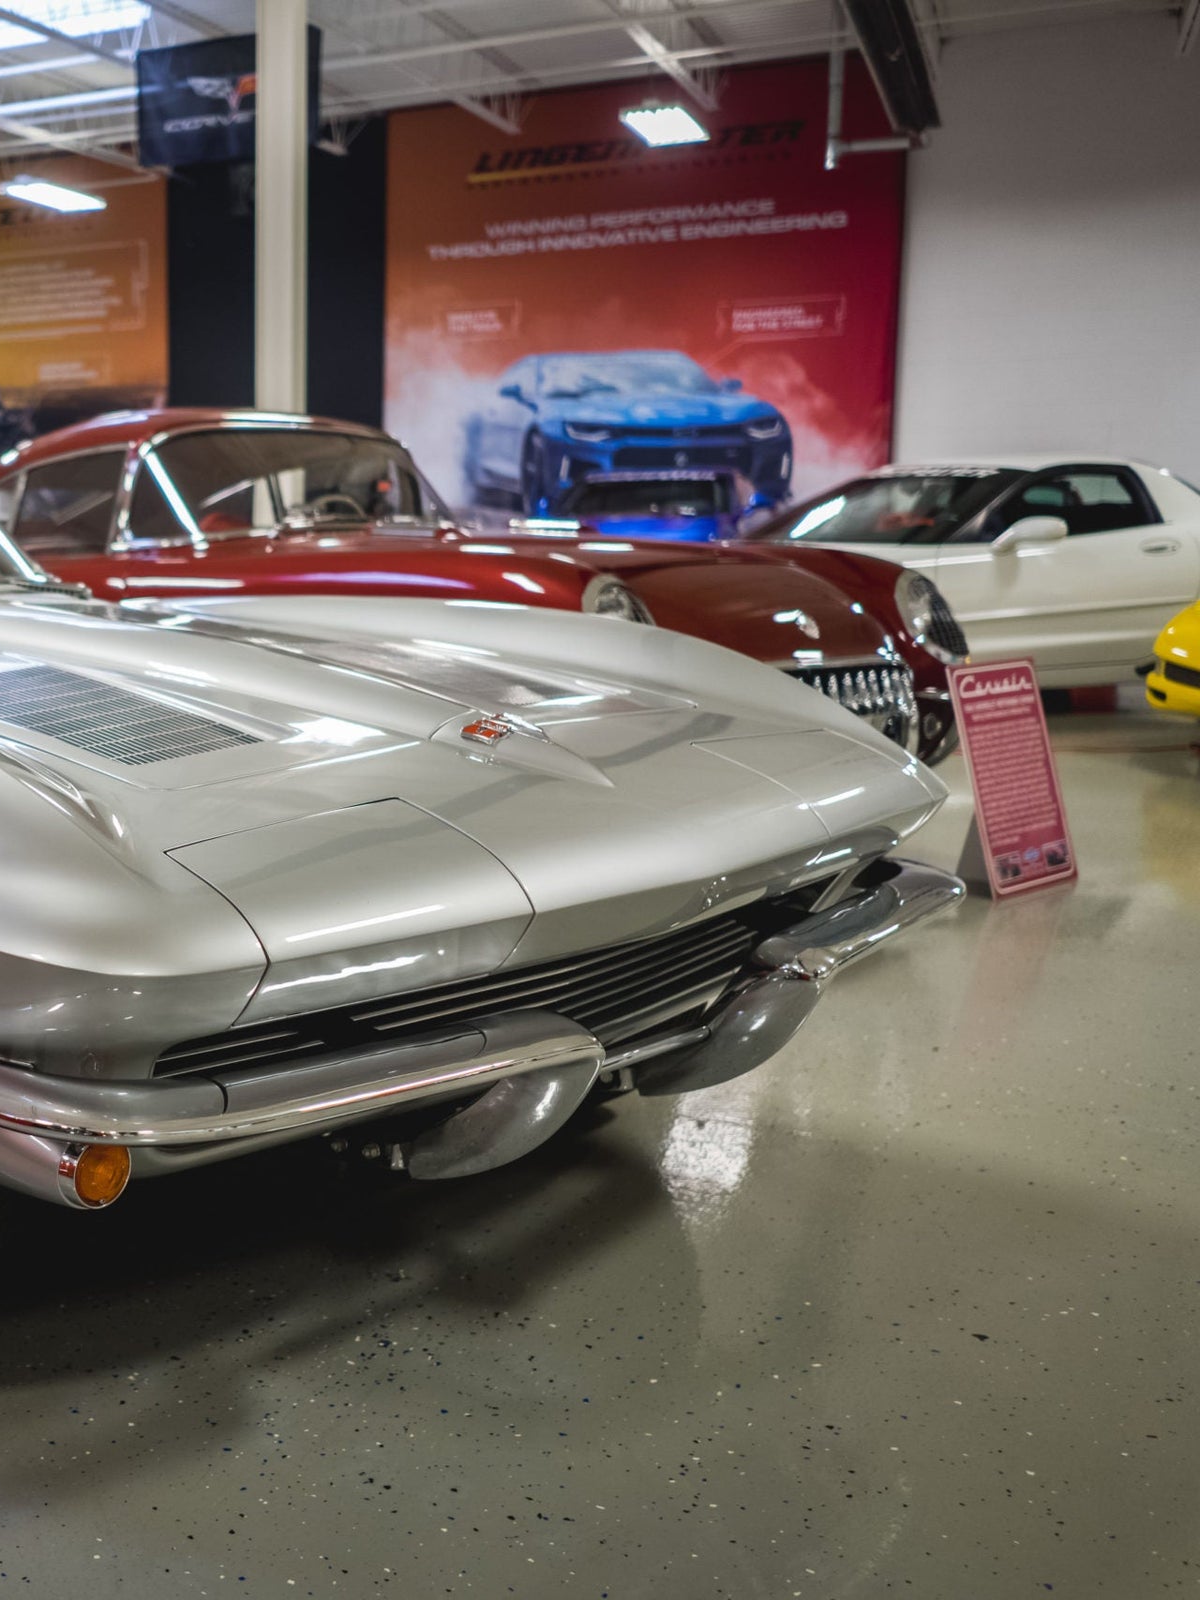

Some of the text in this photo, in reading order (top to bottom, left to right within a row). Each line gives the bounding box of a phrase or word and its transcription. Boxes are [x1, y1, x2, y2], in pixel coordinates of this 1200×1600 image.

[427, 210, 847, 260] THROUGH INNOVATIVE ENGINEERING
[485, 198, 776, 239] WINNING PERFORMANCE
